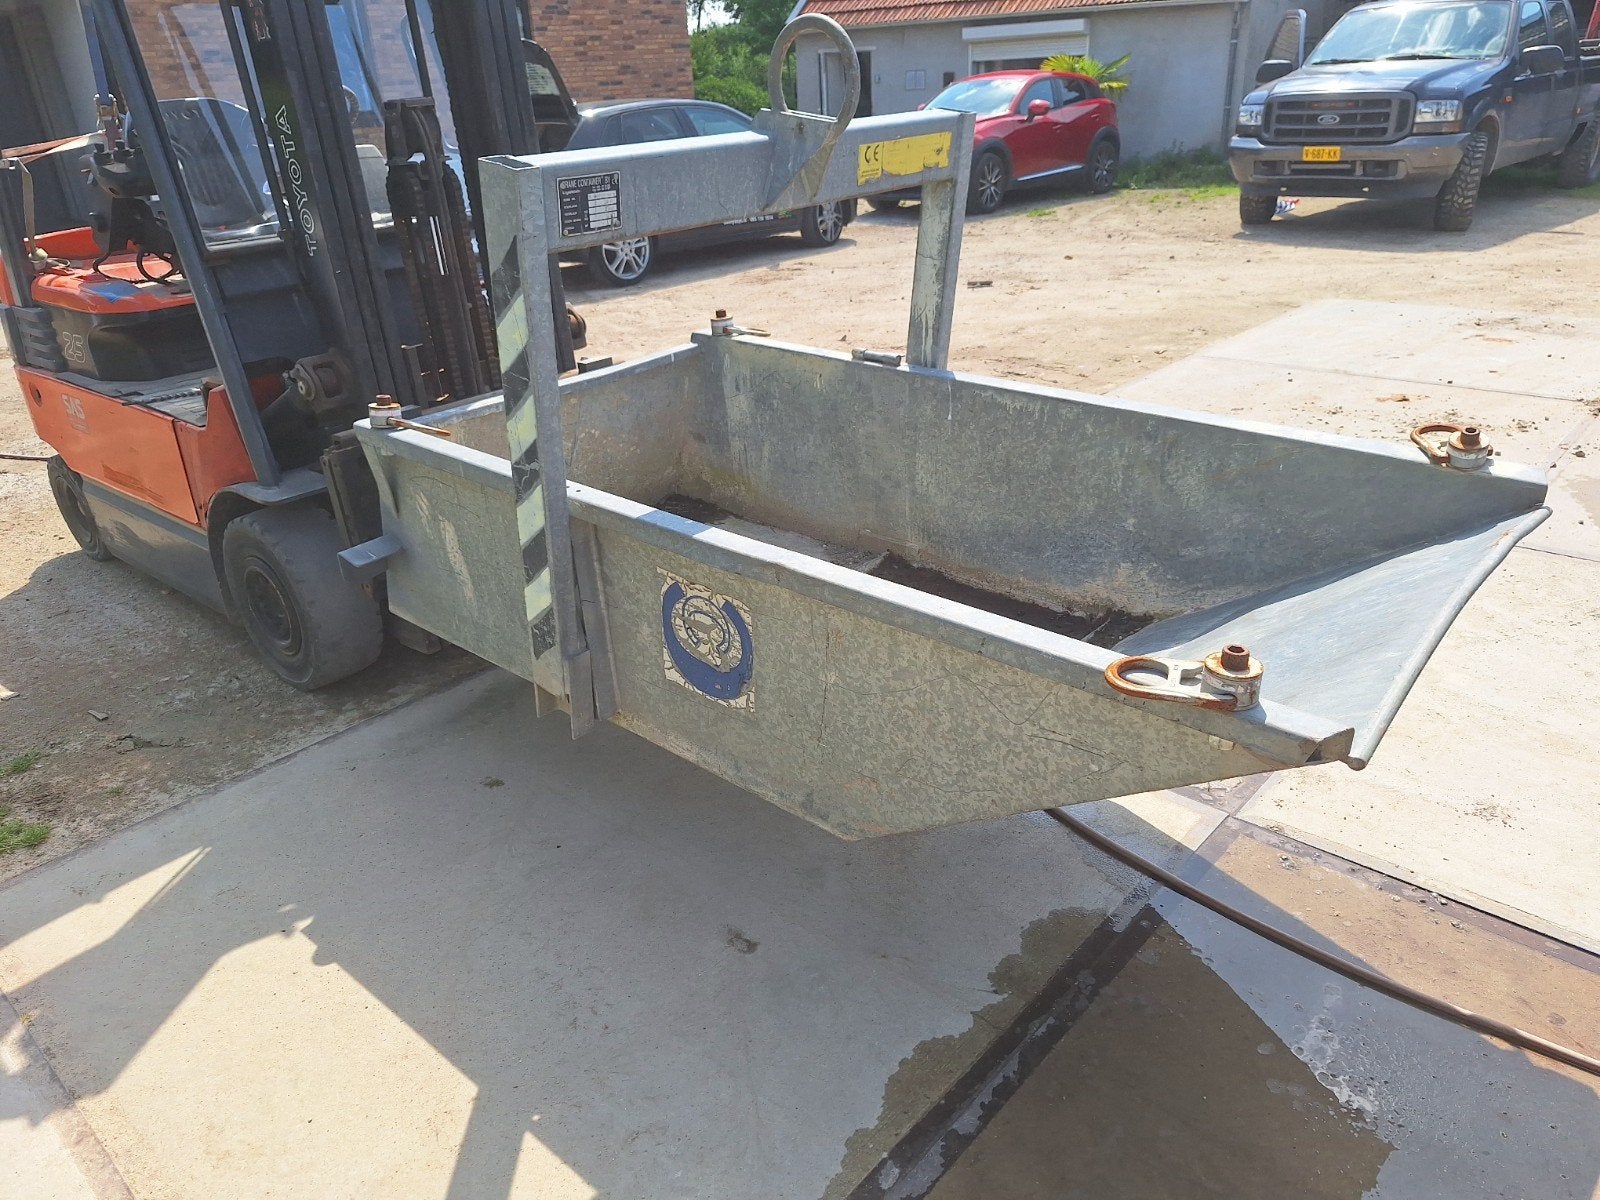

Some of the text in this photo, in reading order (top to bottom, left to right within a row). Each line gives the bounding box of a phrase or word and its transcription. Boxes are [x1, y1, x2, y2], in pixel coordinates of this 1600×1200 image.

[864, 144, 880, 164] CE
[275, 104, 315, 256] TOYOTA
[62, 331, 86, 363] 25
